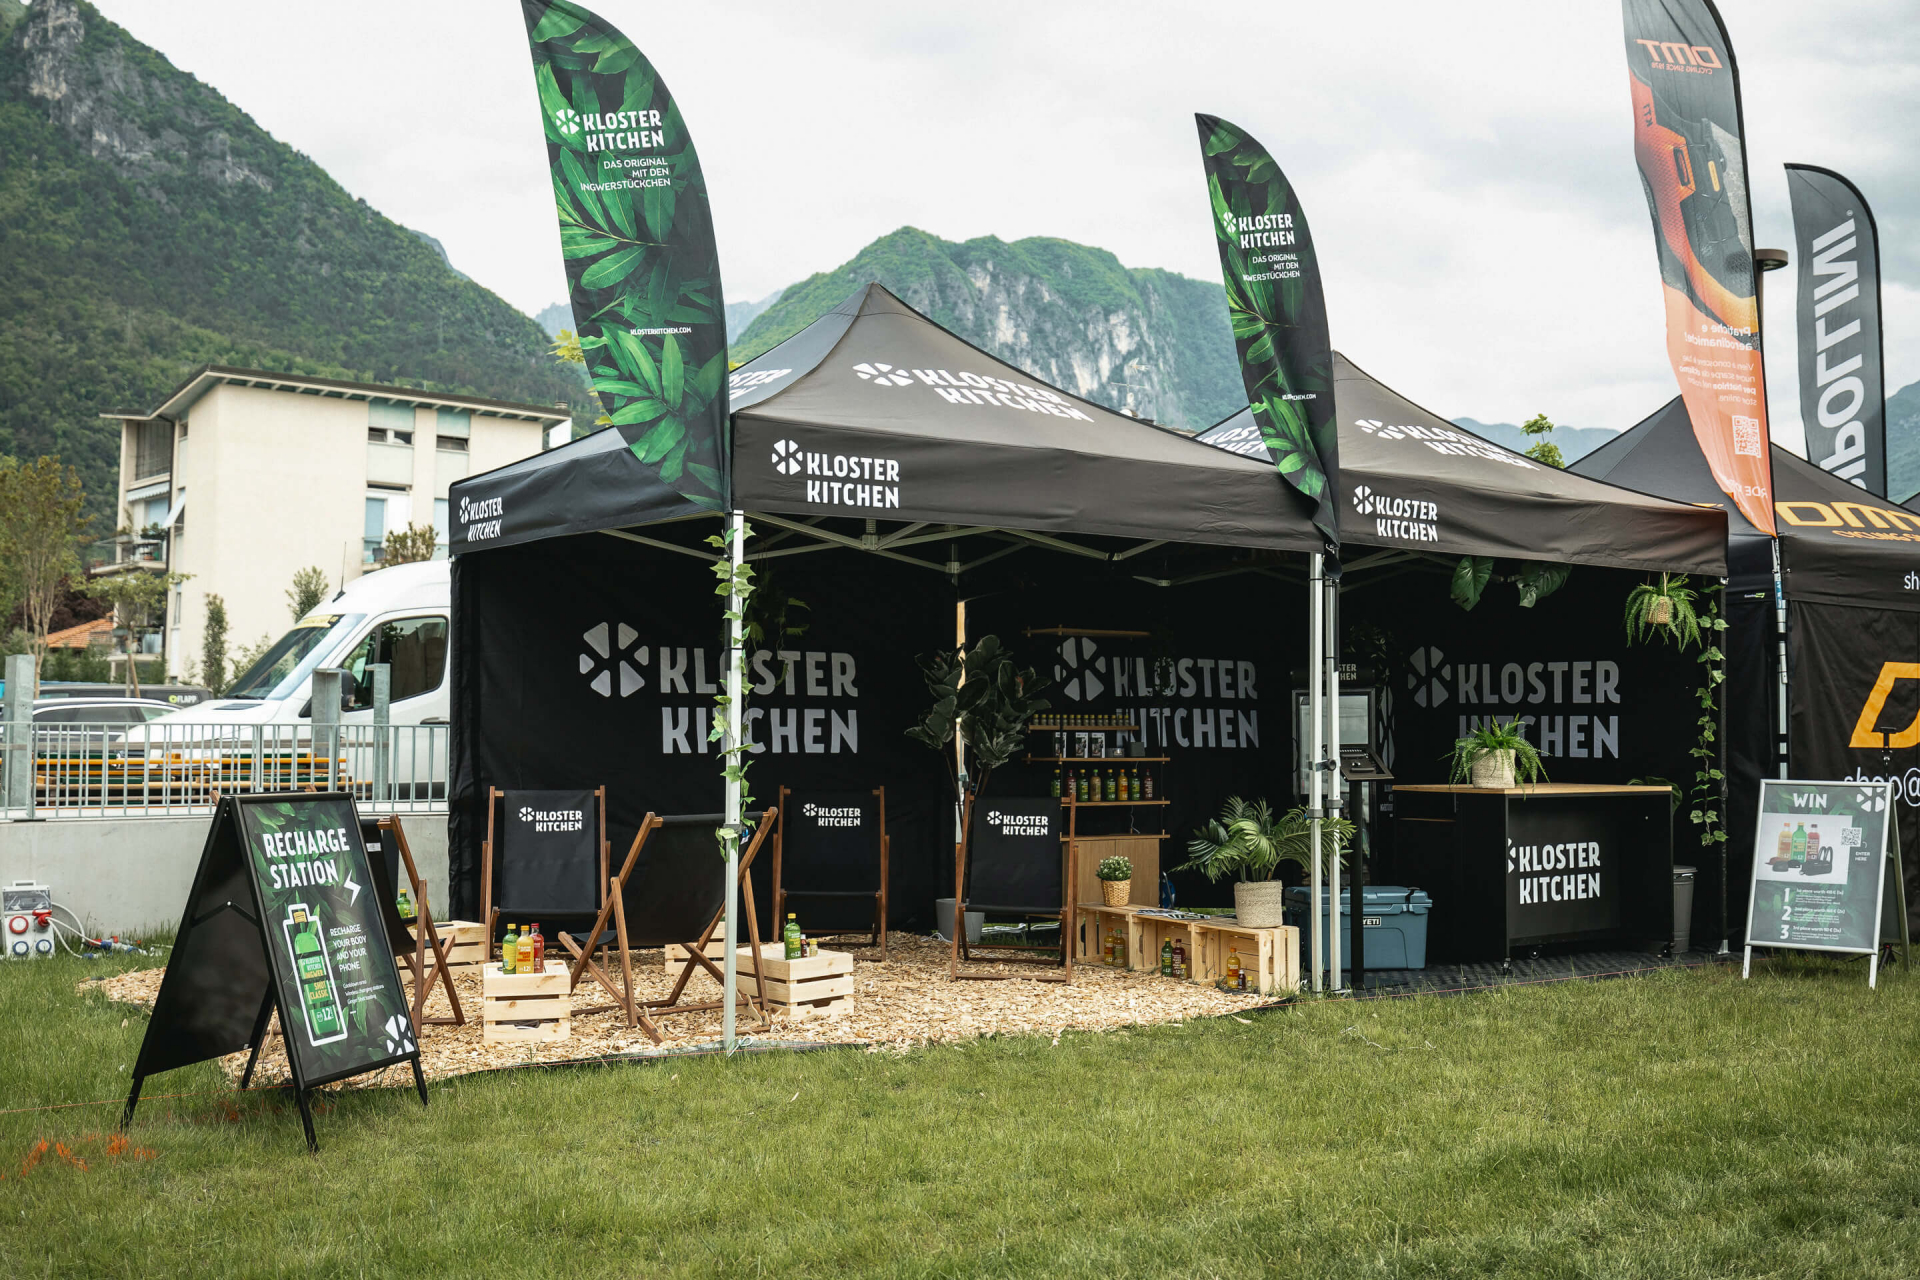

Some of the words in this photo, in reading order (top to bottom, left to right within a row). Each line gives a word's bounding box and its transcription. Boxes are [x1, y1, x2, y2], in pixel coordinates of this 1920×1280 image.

[582, 109, 662, 131] KLOSTER
[585, 130, 665, 153] KITCHEN
[603, 159, 622, 169] DAS
[623, 156, 668, 168] ORIGINAL
[632, 168, 648, 178] MIT
[649, 167, 669, 177] DEN
[580, 177, 671, 192] INGWERSTÜCKCHEN
[1238, 213, 1293, 232] KLOSTER
[1240, 230, 1296, 250] KITCHEN
[1252, 256, 1267, 264] DAS
[1268, 253, 1298, 263] ORIGINAL
[1273, 262, 1285, 271] MIT
[1286, 261, 1299, 270] DEN
[630, 326, 692, 336] KLOSTERKITCHEN.COM
[912, 369, 1072, 407] KLOSTER
[934, 387, 1095, 423] KITCHEN
[1423, 441, 1540, 471] KITCHEN
[806, 452, 901, 483] KLOSTER
[806, 480, 900, 510] KITCHEN
[469, 497, 504, 521] KLOSTER
[1375, 495, 1438, 521] KLOSTER
[467, 519, 502, 543] KITCHEN
[1376, 518, 1439, 542] KITCHEN
[1457, 660, 1621, 704] KLOSTER
[1793, 793, 1827, 809] WIN
[535, 810, 583, 822] KLOSTER
[818, 807, 861, 818] KLOSTER
[1003, 814, 1049, 826] KLOSTER
[535, 820, 583, 832] KITCHEN
[818, 816, 861, 827] KITCHEN
[1002, 825, 1048, 836] KITCHEN
[262, 828, 351, 858] RECHARGE
[1518, 841, 1601, 873] KLOSTER
[270, 859, 339, 890] STATION
[1518, 872, 1601, 905] KITCHEN
[1784, 887, 1790, 902] 1
[1781, 905, 1792, 921] 2
[329, 923, 361, 937] RECHARGE
[1780, 924, 1790, 940] 3
[332, 939, 351, 949] YOUR
[350, 935, 367, 947] BODY
[336, 950, 349, 962] AND
[349, 948, 367, 959] YOUR
[339, 961, 361, 973] PHONE
[313, 980, 326, 991] SHOT
[309, 988, 329, 1000] CLASSIC
